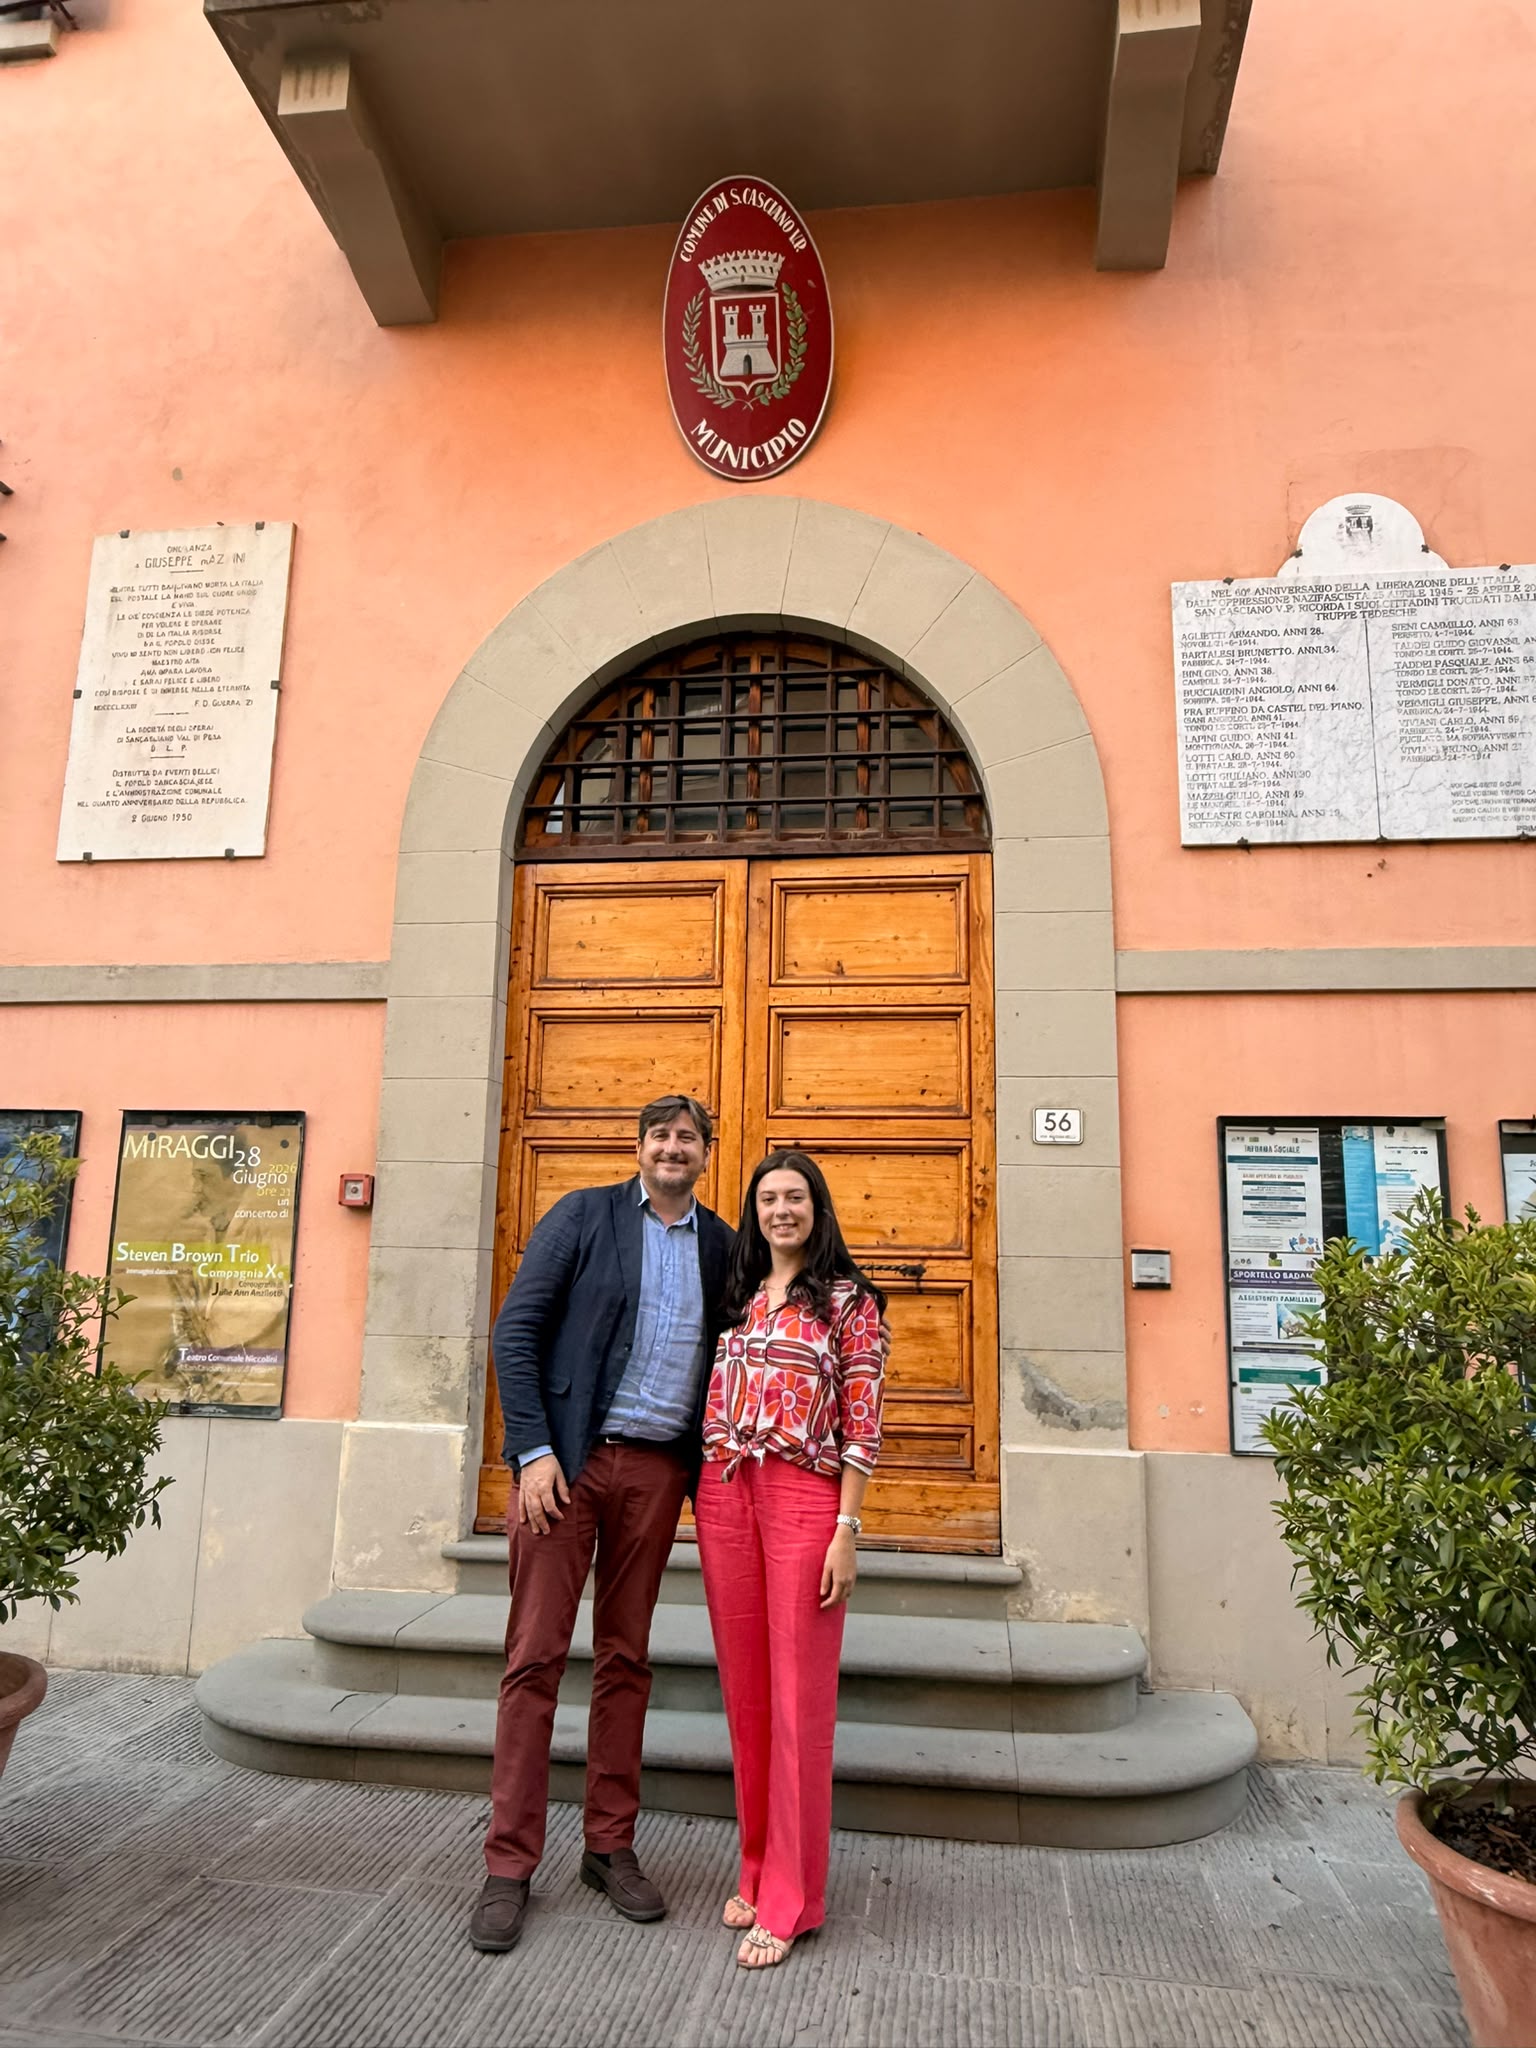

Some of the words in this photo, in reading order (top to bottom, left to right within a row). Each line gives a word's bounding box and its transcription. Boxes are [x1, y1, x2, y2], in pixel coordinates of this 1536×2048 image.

[680, 204, 717, 262] COMUNE
[712, 192, 730, 214] DI
[690, 418, 807, 470] MUNICIPIO
[145, 555, 192, 568] GIUSEPPE
[1211, 589, 1232, 598] NEL
[1254, 584, 1332, 596] ANNIVERSARIO
[1335, 582, 1370, 592] DELLA
[1376, 579, 1447, 590] LIBERAZIONE
[1430, 586, 1453, 597] 1945
[1466, 586, 1479, 595] 25
[1195, 608, 1216, 617] SAN
[1219, 605, 1273, 616] CASCIANO
[1299, 602, 1345, 612] RICORDA
[1382, 598, 1438, 608] CITTADINI
[1441, 595, 1501, 606] TRUCIDATI
[217, 608, 251, 616] POTENZA
[1315, 611, 1358, 620] TRUPPE
[1360, 608, 1417, 619] TEDESCHE
[1478, 618, 1504, 628] ANNI
[1283, 627, 1307, 636] ANNI
[1234, 668, 1258, 676] ANNI
[1297, 684, 1322, 693] ANNI
[1503, 695, 1529, 705] ANNI
[1251, 705, 1265, 714] DA
[1267, 704, 1306, 713] CASTEL
[1479, 715, 1505, 725] ANNI
[1256, 732, 1280, 741] ANNI
[1483, 743, 1509, 752] ANNI
[1186, 753, 1215, 762] LOTTI
[1256, 751, 1281, 760] ANNI
[1187, 773, 1216, 782] LOTTI
[1265, 790, 1289, 799] ANNI
[172, 813, 192, 821] 1950
[1188, 810, 1242, 821] POLLASTRI
[1044, 1112, 1072, 1132] 56
[234, 1146, 261, 1167] 28
[233, 1169, 288, 1189] Giugno
[277, 1198, 289, 1206] un
[234, 1210, 278, 1218] concerto
[279, 1208, 289, 1218] di
[115, 1242, 168, 1261] Steven
[171, 1242, 222, 1262] Brown
[226, 1244, 259, 1263] Trio
[197, 1262, 264, 1280] Compagnia
[1233, 1270, 1281, 1279] SPORTELLO
[234, 1289, 249, 1297] Ann
[178, 1347, 207, 1362] Teatro
[245, 1354, 278, 1364] Niccolini
